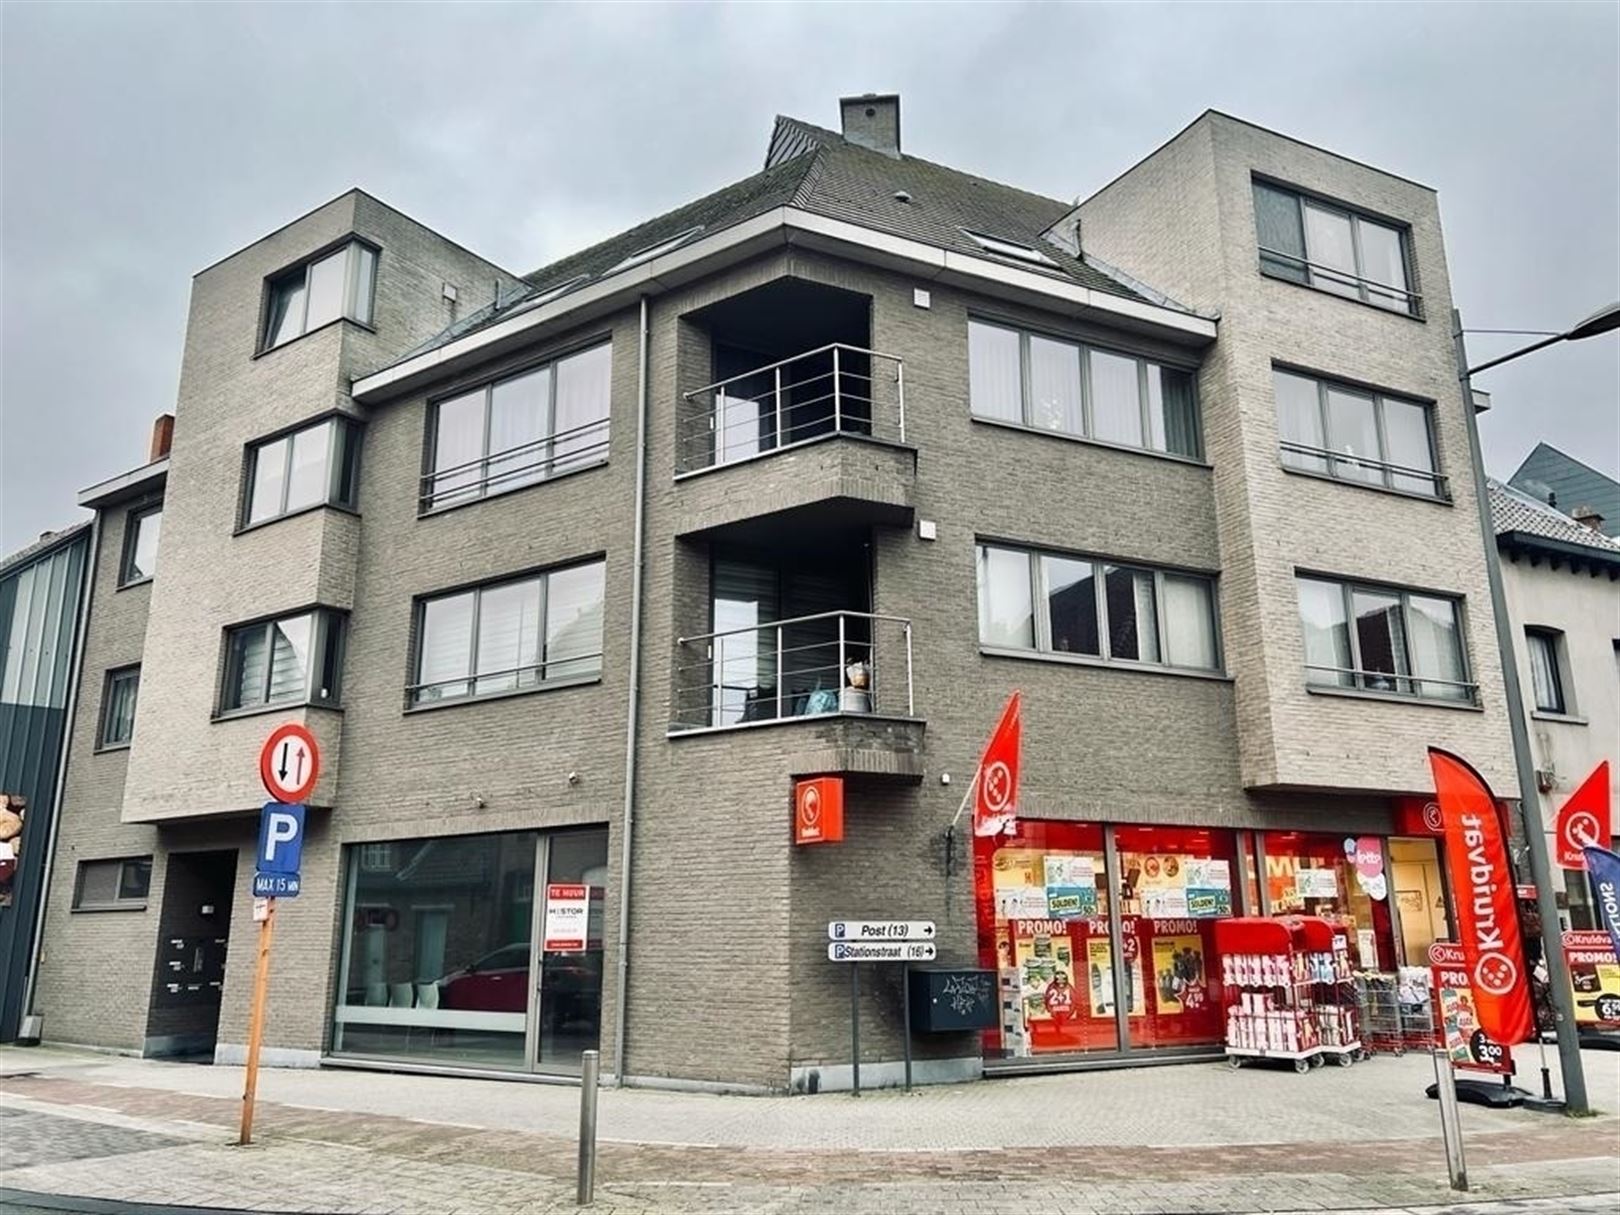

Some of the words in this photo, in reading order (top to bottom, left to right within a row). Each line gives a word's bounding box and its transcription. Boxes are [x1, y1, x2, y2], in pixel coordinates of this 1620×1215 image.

[265, 812, 298, 860] P
[256, 877, 274, 891] MAX
[276, 878, 286, 892] 15
[550, 888, 561, 898] TE
[861, 925, 888, 937] Post
[888, 923, 909, 937] (13)
[1017, 920, 1068, 935] PROMO!
[1153, 919, 1199, 934] PROMO!
[1575, 935, 1612, 946] Kruidva
[844, 946, 901, 959] Stationstraat
[907, 945, 925, 959] (16)
[1445, 949, 1465, 960] Kru
[1568, 951, 1618, 964] PROMO!
[1440, 971, 1469, 986] PRO
[1048, 989, 1071, 1006] 2+1
